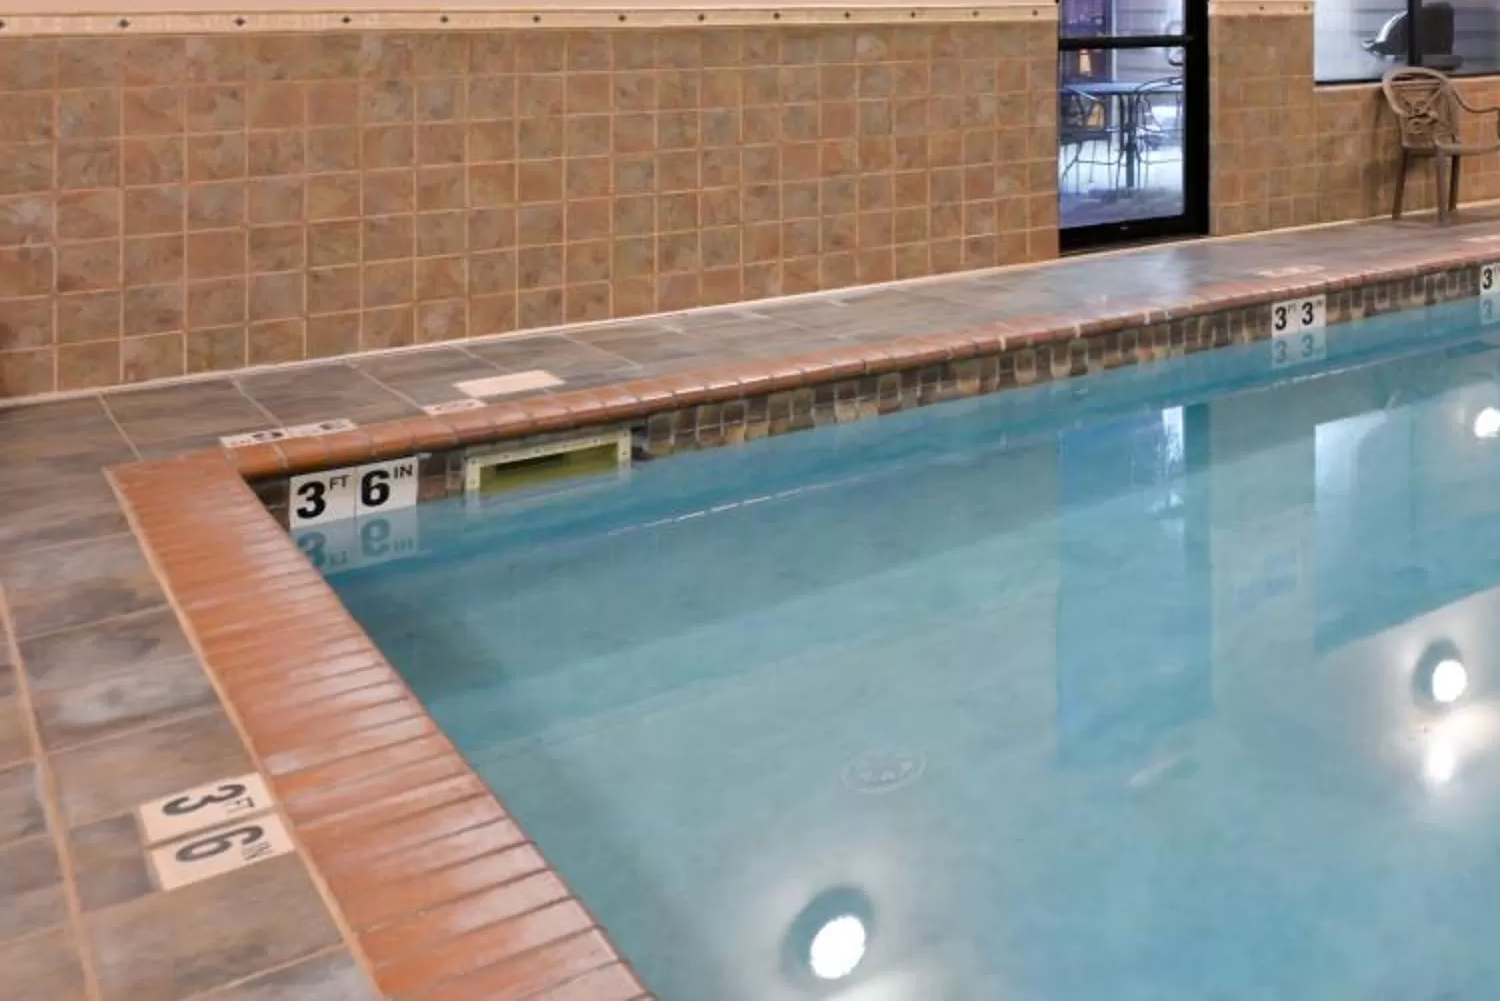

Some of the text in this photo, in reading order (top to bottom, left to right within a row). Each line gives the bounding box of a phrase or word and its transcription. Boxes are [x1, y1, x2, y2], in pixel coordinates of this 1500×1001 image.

[1482, 268, 1493, 290] 3
[1275, 306, 1287, 330] 3
[1301, 301, 1314, 326] 3
[296, 463, 413, 519] 3 FT 6 IN
[162, 784, 246, 816] 3
[175, 825, 264, 862] 6
